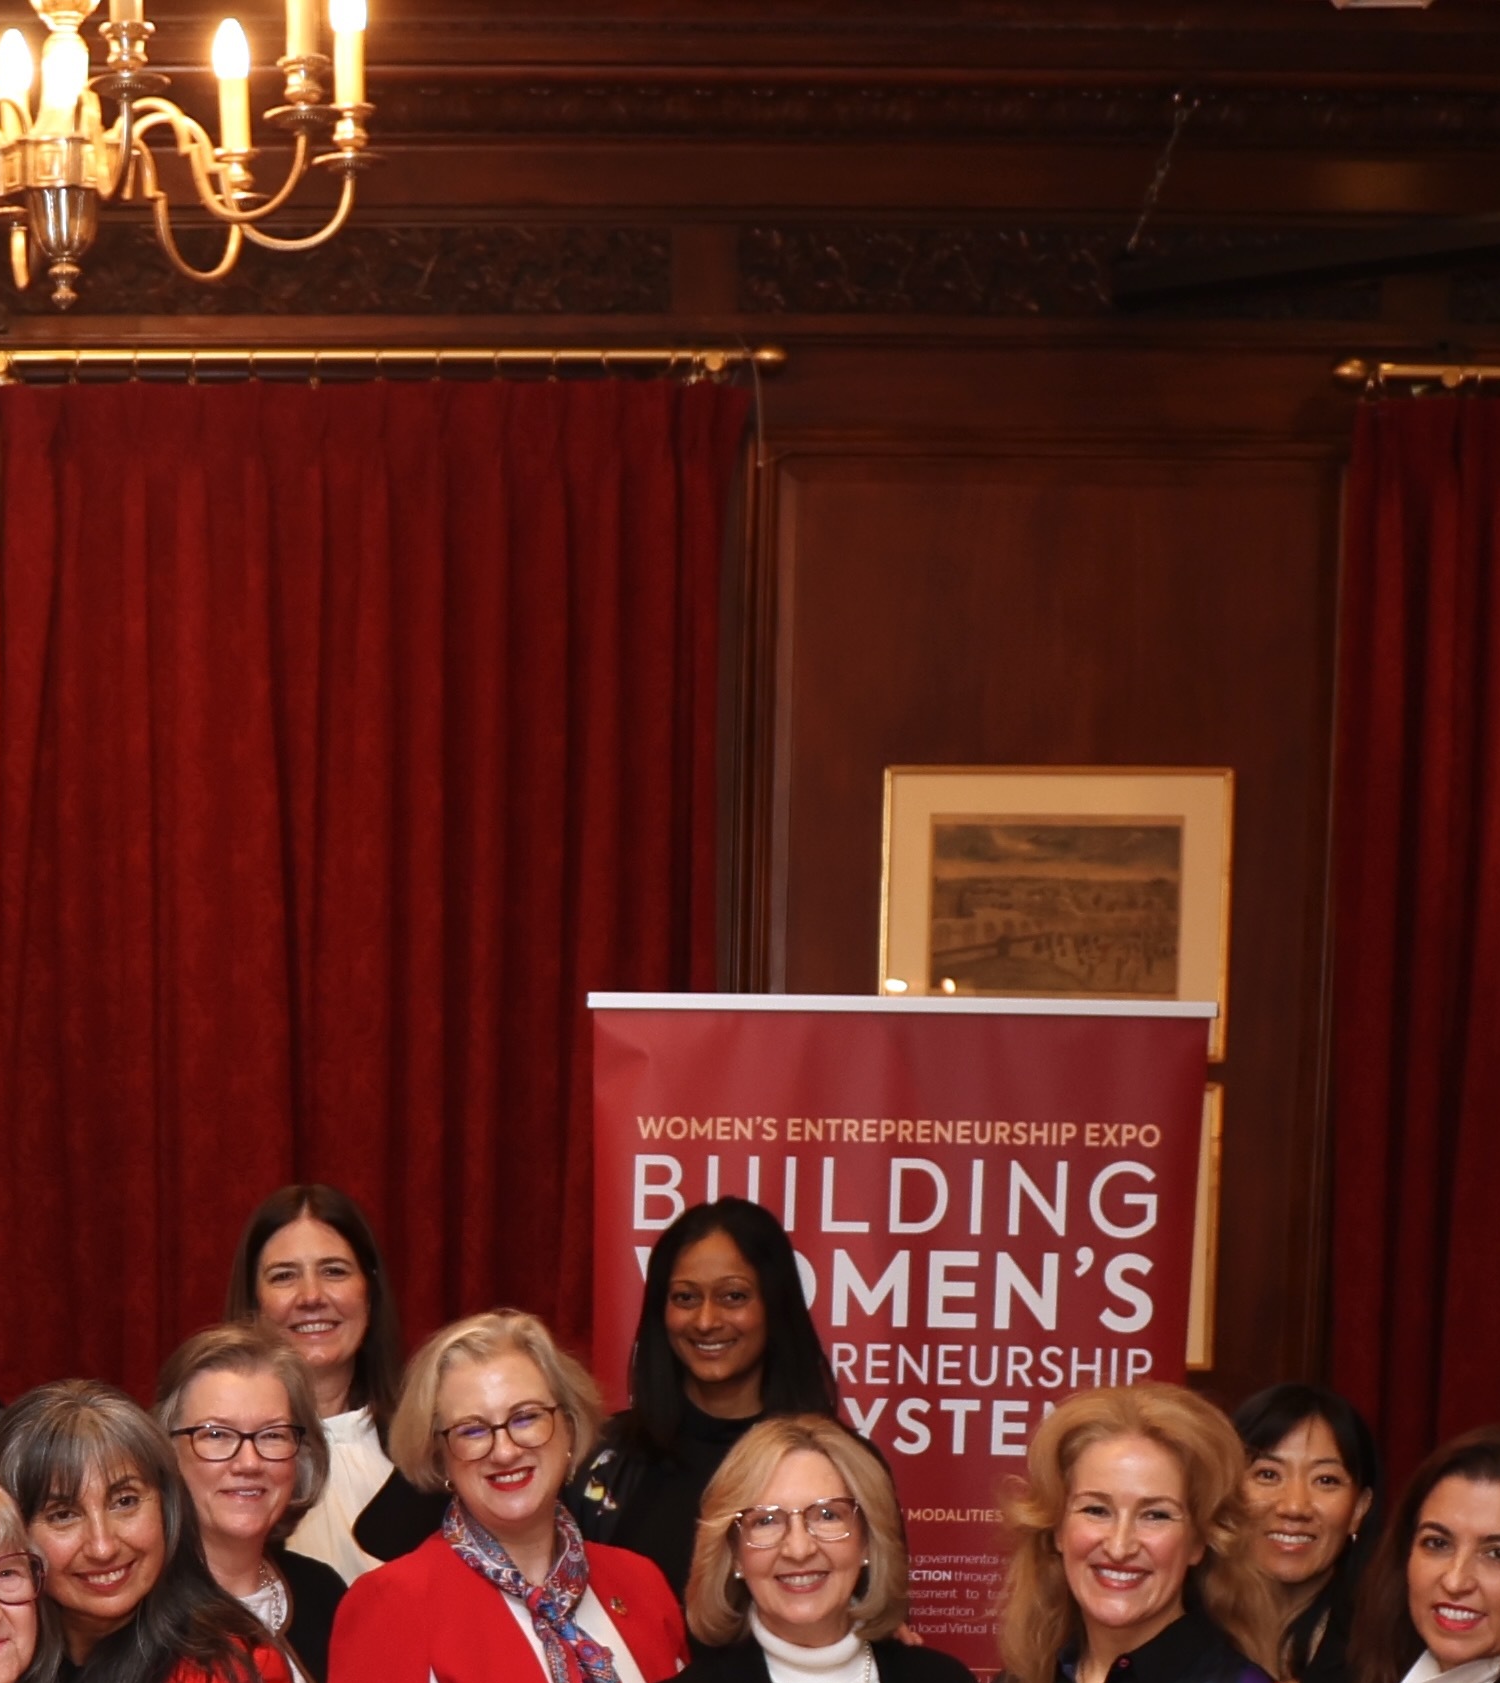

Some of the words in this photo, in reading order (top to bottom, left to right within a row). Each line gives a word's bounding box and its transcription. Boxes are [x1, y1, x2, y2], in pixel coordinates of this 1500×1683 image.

[637, 1115, 778, 1142] WOMEN'S
[787, 1118, 1077, 1146] ENTREPRENEURSHIP
[1084, 1124, 1162, 1148] EXPO
[635, 1246, 1155, 1333] MEN'S
[831, 1342, 1153, 1388] RENEURSHIP
[908, 1508, 1004, 1523] MODALITIES
[908, 1588, 957, 1599] essment
[908, 1604, 975, 1617] nsideration
